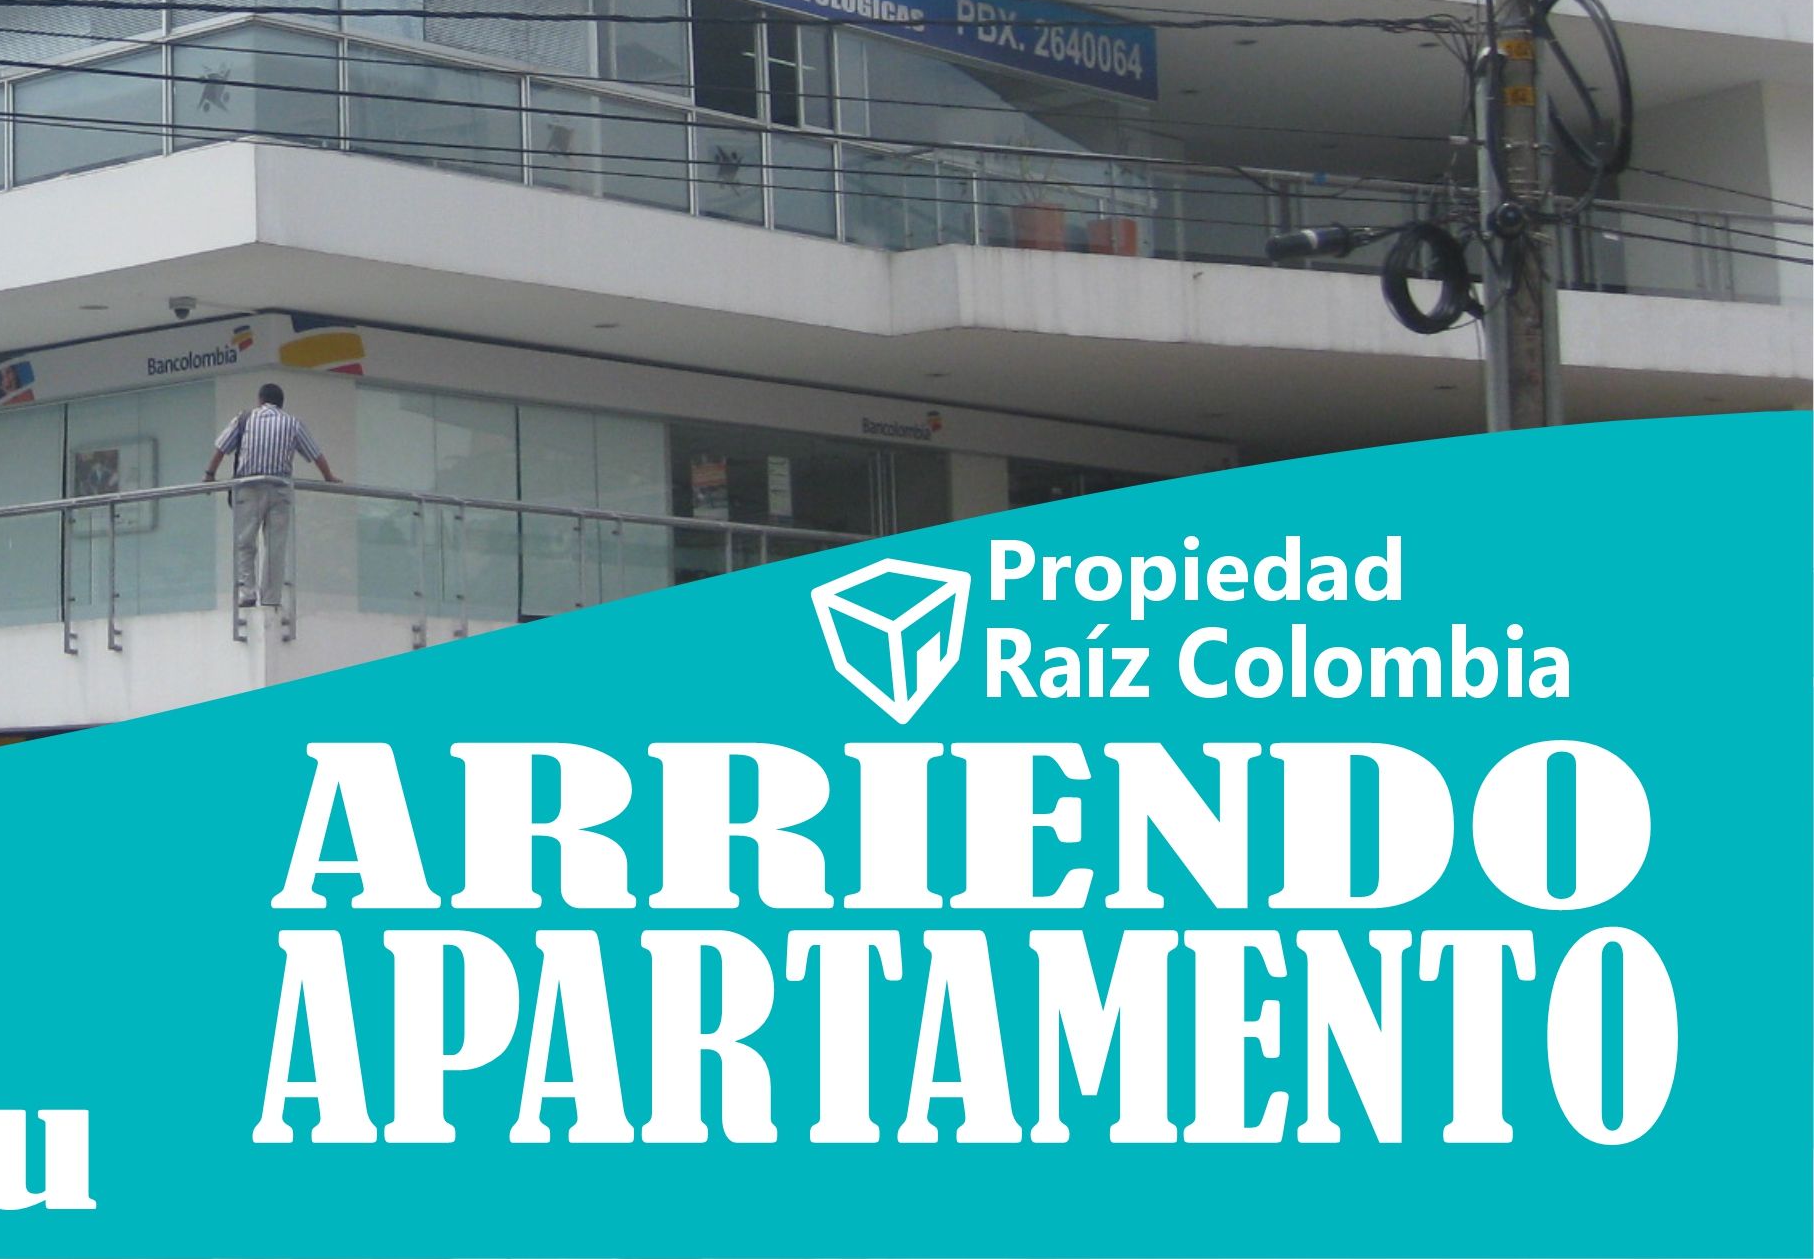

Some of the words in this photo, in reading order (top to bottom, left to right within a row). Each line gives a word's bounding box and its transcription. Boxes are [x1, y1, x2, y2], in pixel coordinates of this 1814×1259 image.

[1034, 18, 1142, 80] 2640064
[148, 345, 237, 375] Bancolombia
[862, 417, 931, 440] Bancolombia
